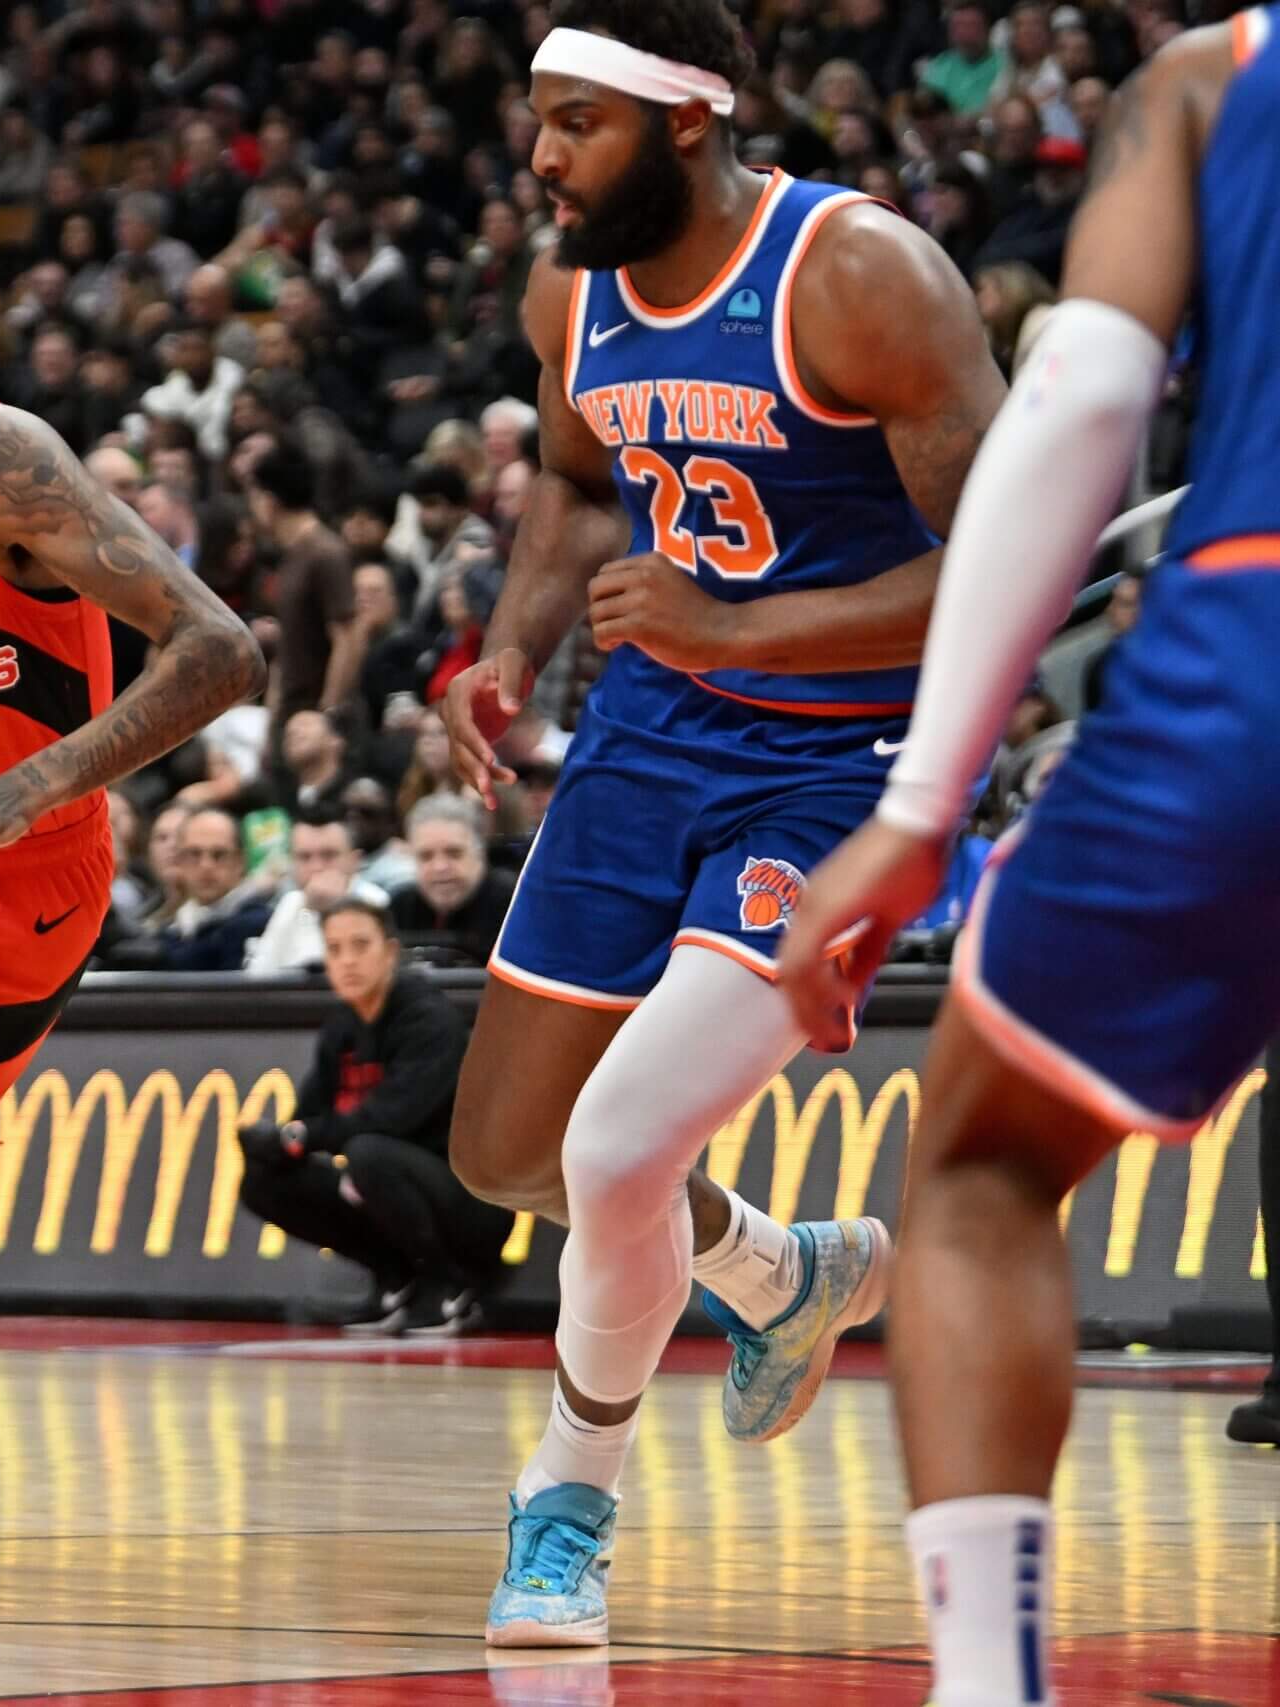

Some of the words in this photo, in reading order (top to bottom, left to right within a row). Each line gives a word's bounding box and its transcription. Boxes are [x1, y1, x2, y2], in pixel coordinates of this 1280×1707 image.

[719, 320, 765, 336] sphere
[576, 380, 654, 447] NEW
[656, 379, 788, 450] YORK
[620, 445, 779, 580] 23
[739, 860, 800, 912] KNICK
